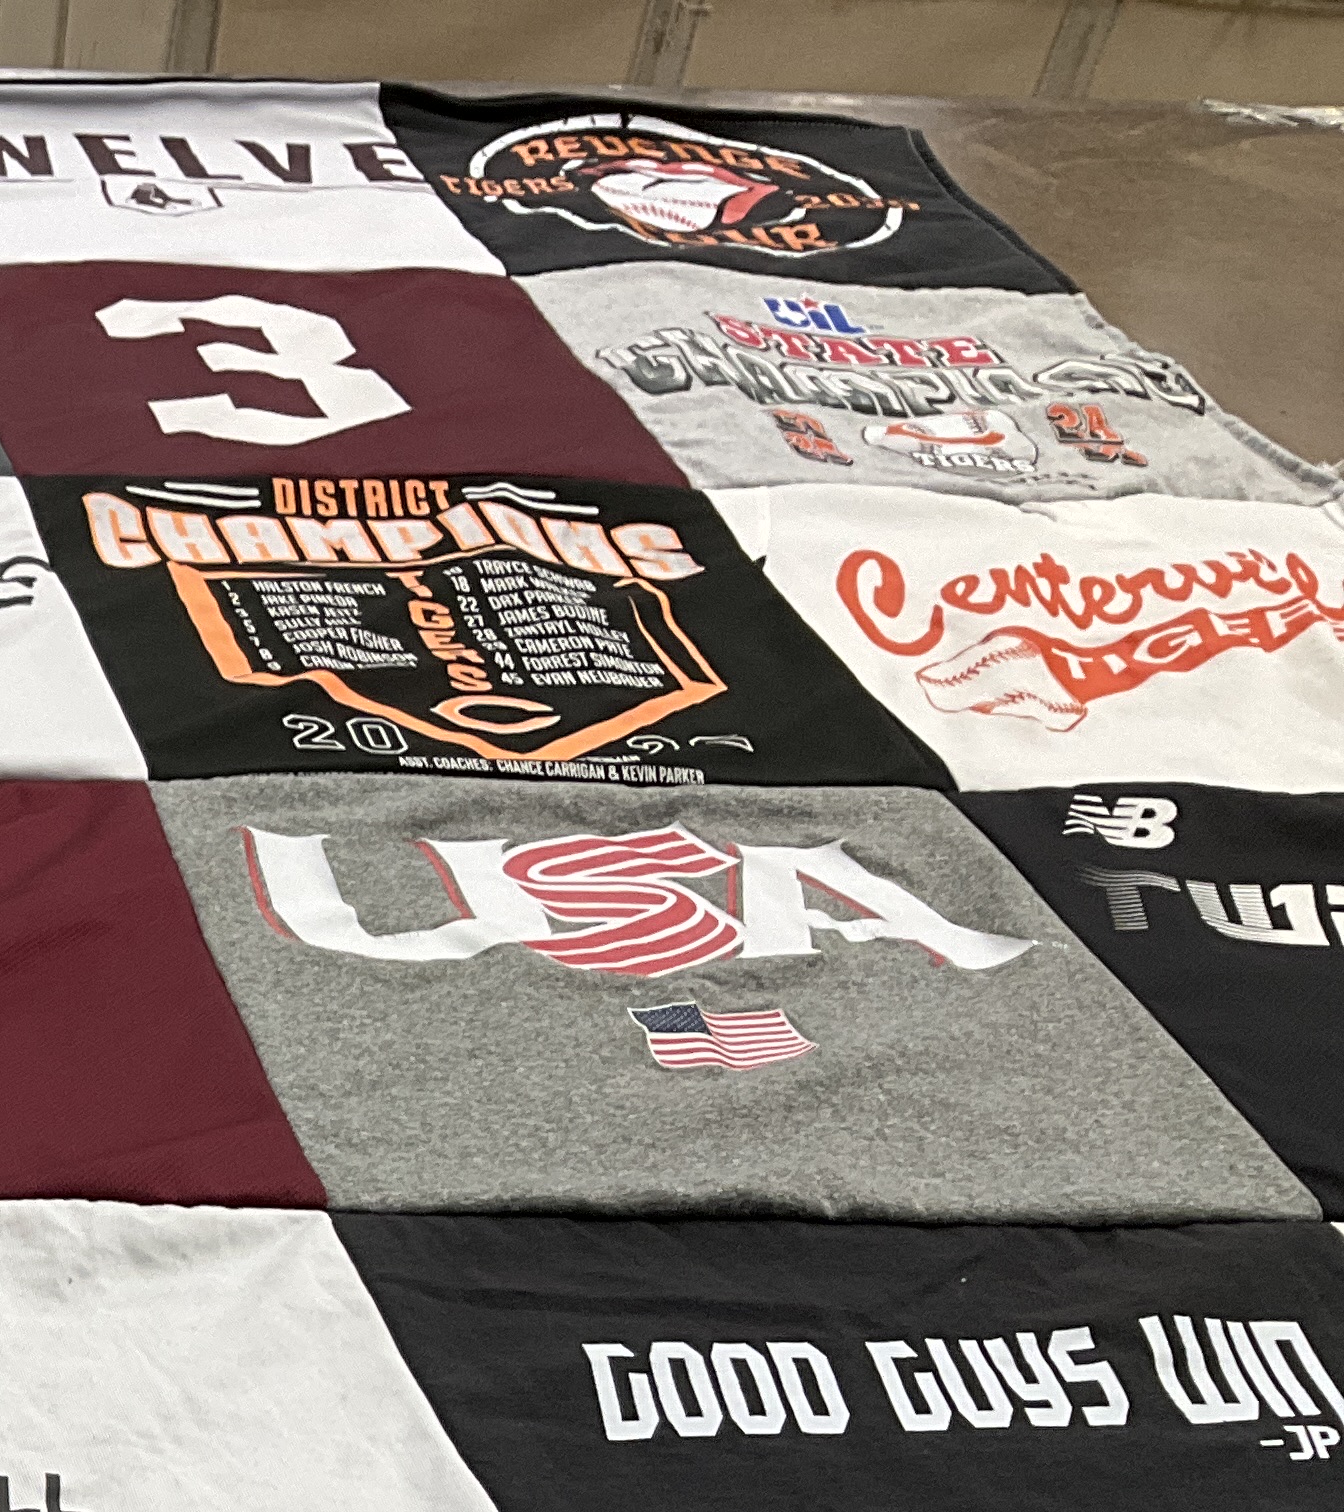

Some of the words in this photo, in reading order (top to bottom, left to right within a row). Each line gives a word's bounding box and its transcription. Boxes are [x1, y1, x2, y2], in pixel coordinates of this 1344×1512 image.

[510, 134, 812, 179] REVENGE
[440, 173, 579, 198] TIGERS
[706, 311, 1006, 366] STATE
[95, 294, 411, 445] 3
[273, 477, 450, 518] DISTRICT
[83, 492, 705, 580] CHAMPIONS
[324, 581, 386, 596] FRENCH
[450, 576, 471, 593] 18
[479, 577, 530, 593] MARK
[456, 595, 480, 613] 22
[497, 606, 551, 626] JAMES
[349, 627, 404, 651] FISHER
[514, 635, 594, 654] CAMERON
[493, 652, 516, 671] 44
[522, 652, 589, 672] FORREST
[282, 713, 409, 756] 20
[495, 758, 544, 777] CHANCE
[545, 761, 605, 781] CARRIGAN
[608, 765, 619, 782] &
[620, 764, 658, 783] KEVIN
[658, 767, 706, 786] PARKER
[238, 821, 1039, 977] USA
[583, 1341, 850, 1441] GOOD
[866, 1327, 1130, 1431] GUYS
[1139, 1314, 1344, 1425] WIN
